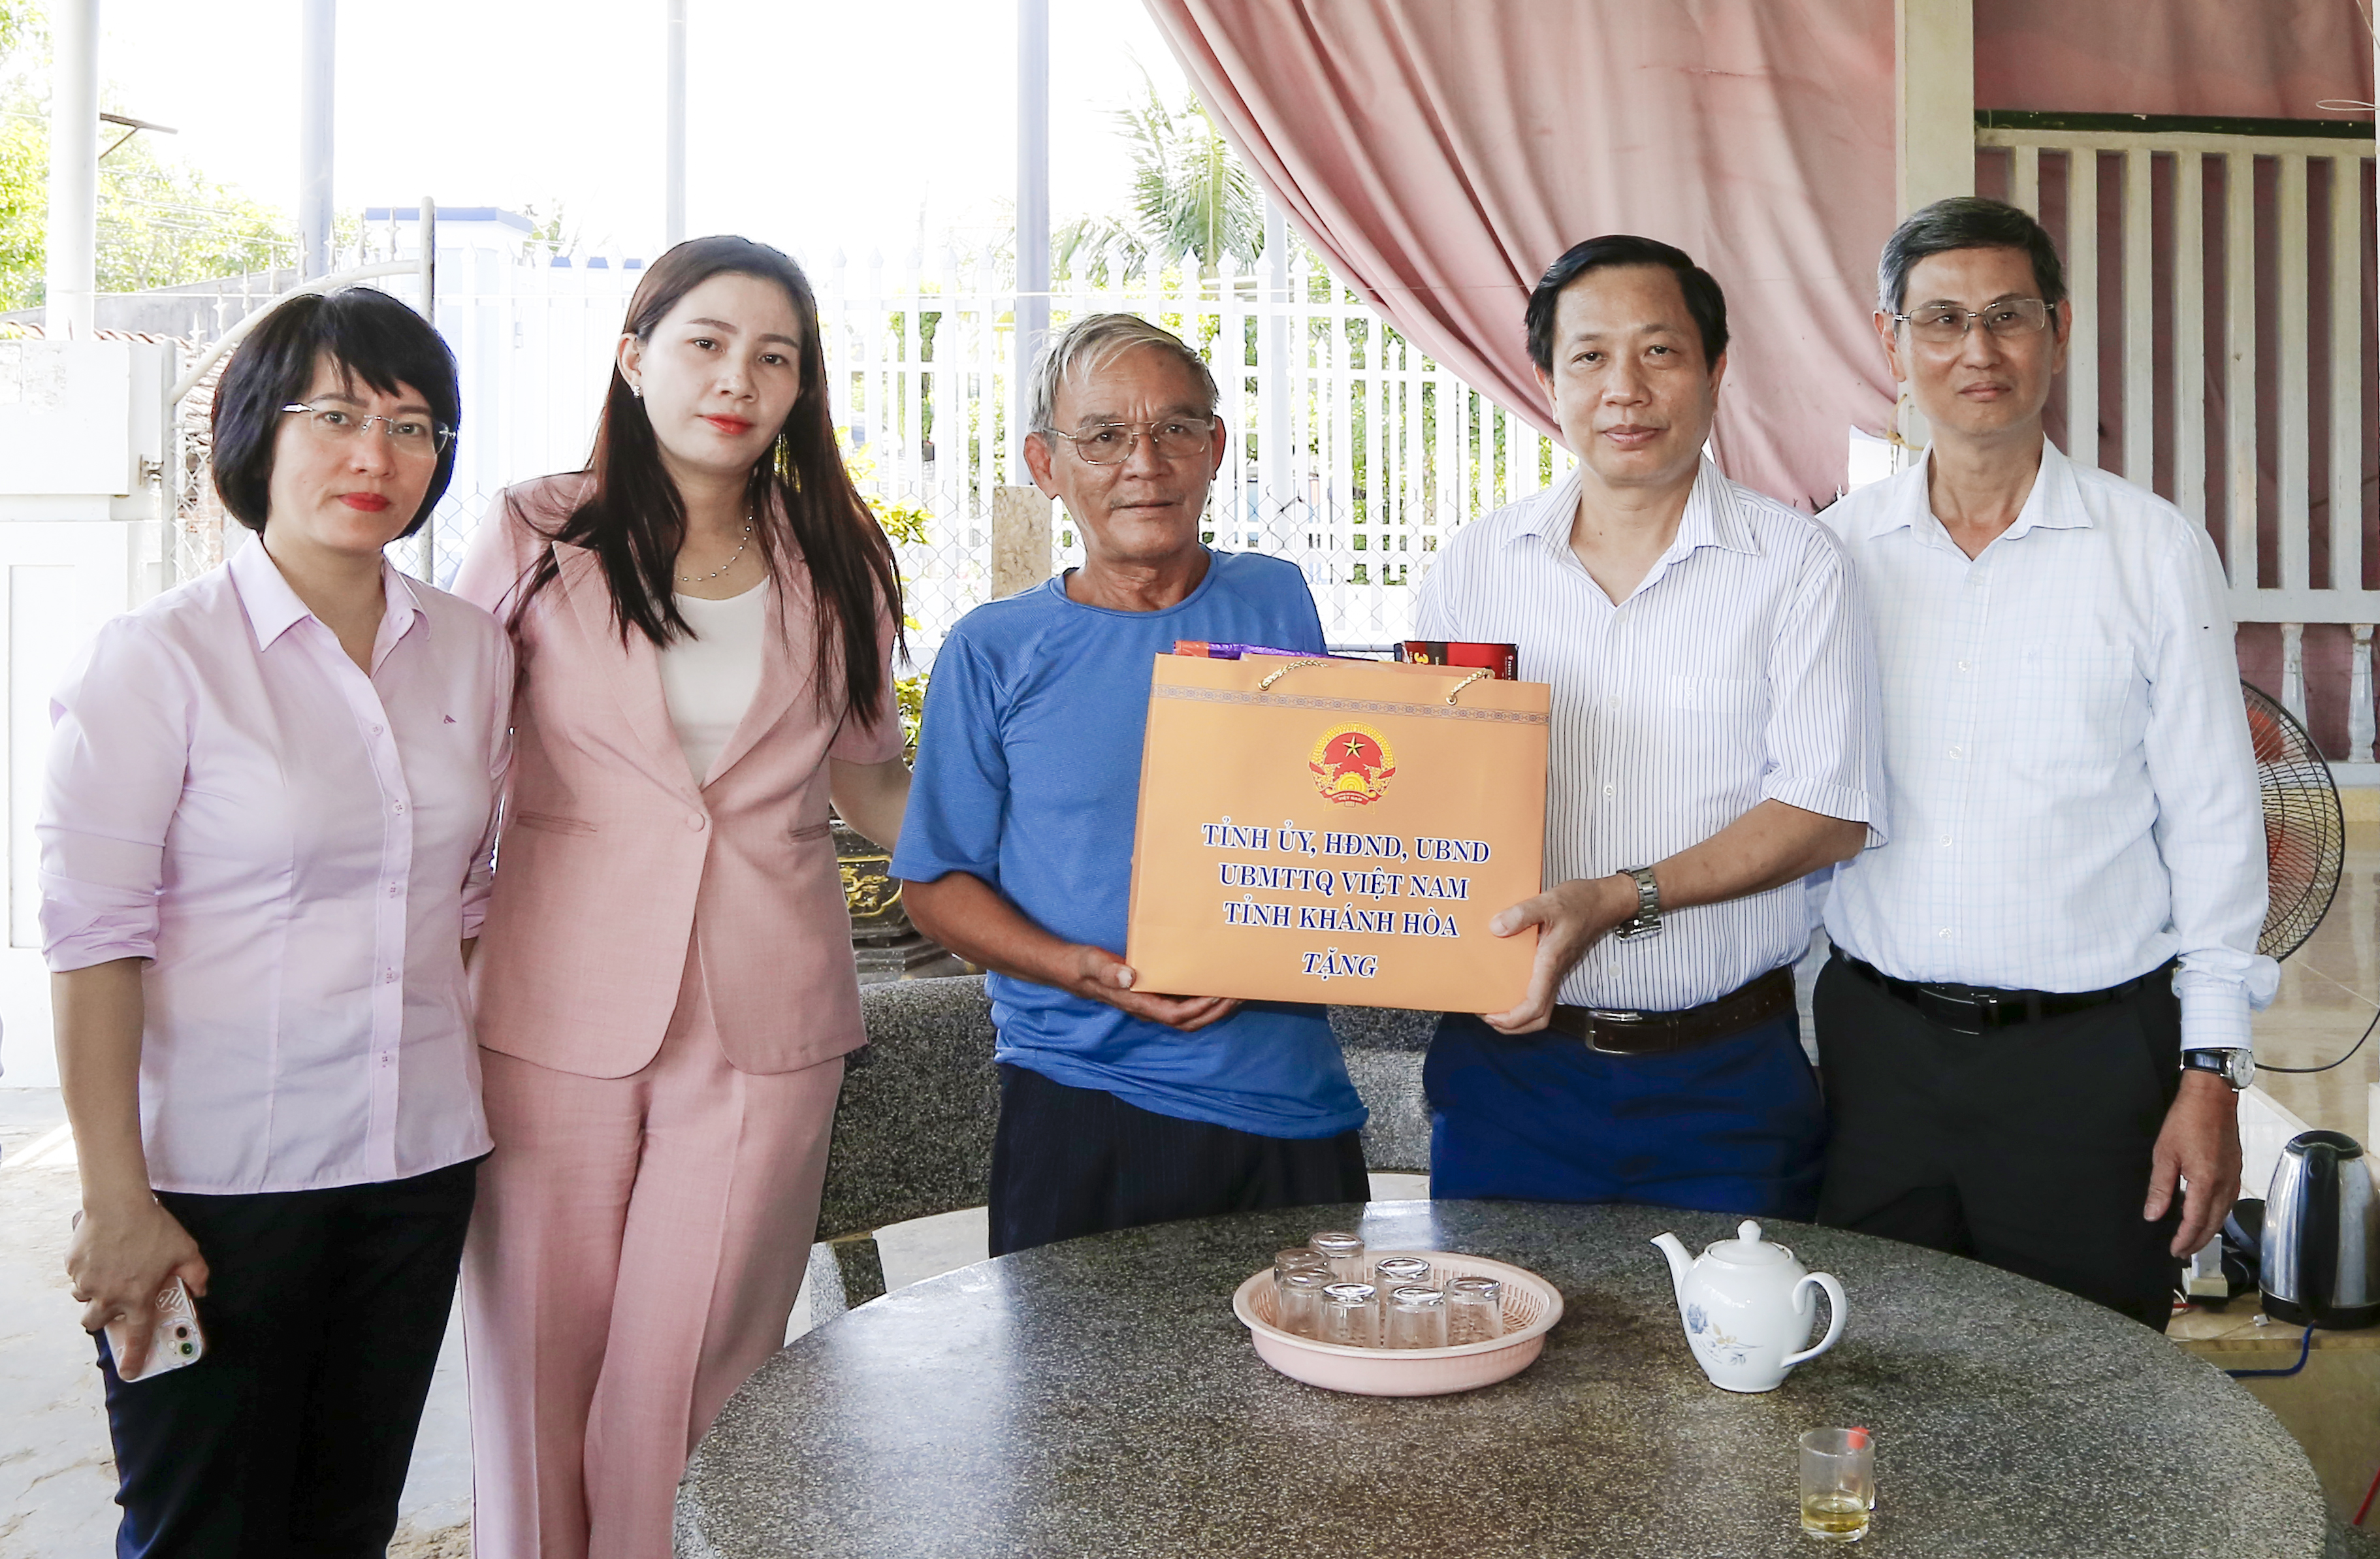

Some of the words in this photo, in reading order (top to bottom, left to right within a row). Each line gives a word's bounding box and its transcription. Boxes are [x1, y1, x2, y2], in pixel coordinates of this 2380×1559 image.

[1202, 816, 1270, 850] TỈNH
[1278, 820, 1317, 858] ỦY,
[1324, 832, 1407, 863] HĐND,
[1415, 837, 1490, 863] UBND
[1219, 863, 1334, 896] UBMTTQ
[1341, 867, 1404, 900] VIỆT
[1409, 875, 1469, 899] NAM
[1224, 894, 1293, 927] TỈNH
[1298, 903, 1395, 933] KHÁNH
[1402, 907, 1459, 937] HÒA
[1302, 948, 1377, 980] TẶNG
